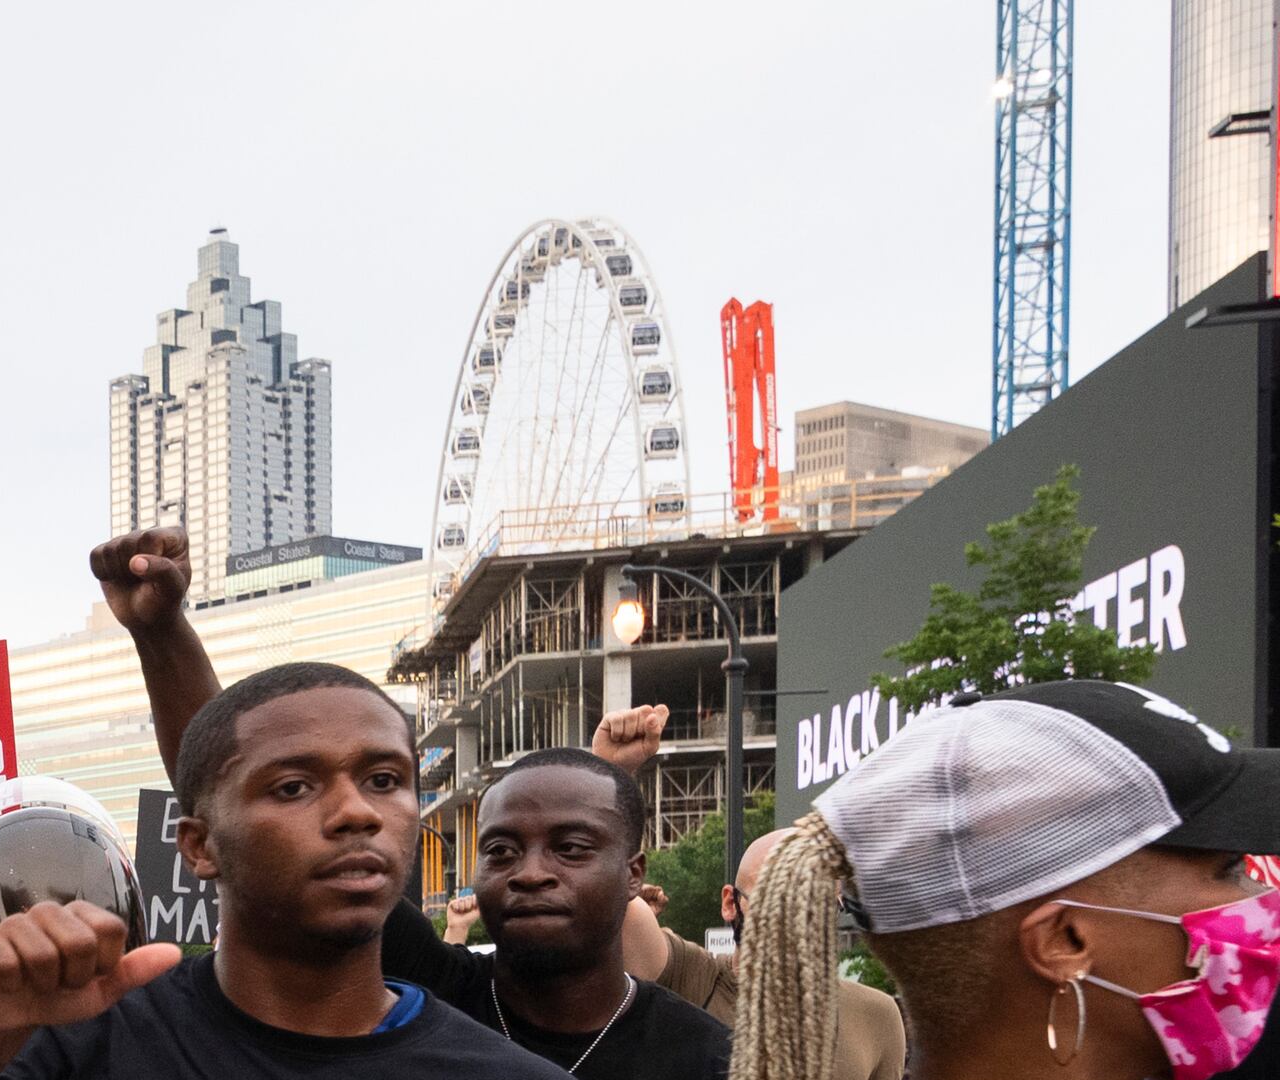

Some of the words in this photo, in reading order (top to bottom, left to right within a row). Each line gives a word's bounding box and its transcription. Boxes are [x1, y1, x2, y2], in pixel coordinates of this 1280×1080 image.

[235, 551, 273, 571] Coastal
[278, 544, 310, 561] States
[344, 541, 376, 558] Coastal
[379, 545, 405, 562] States
[797, 685, 880, 790] BLACK
[150, 894, 219, 943] MA
